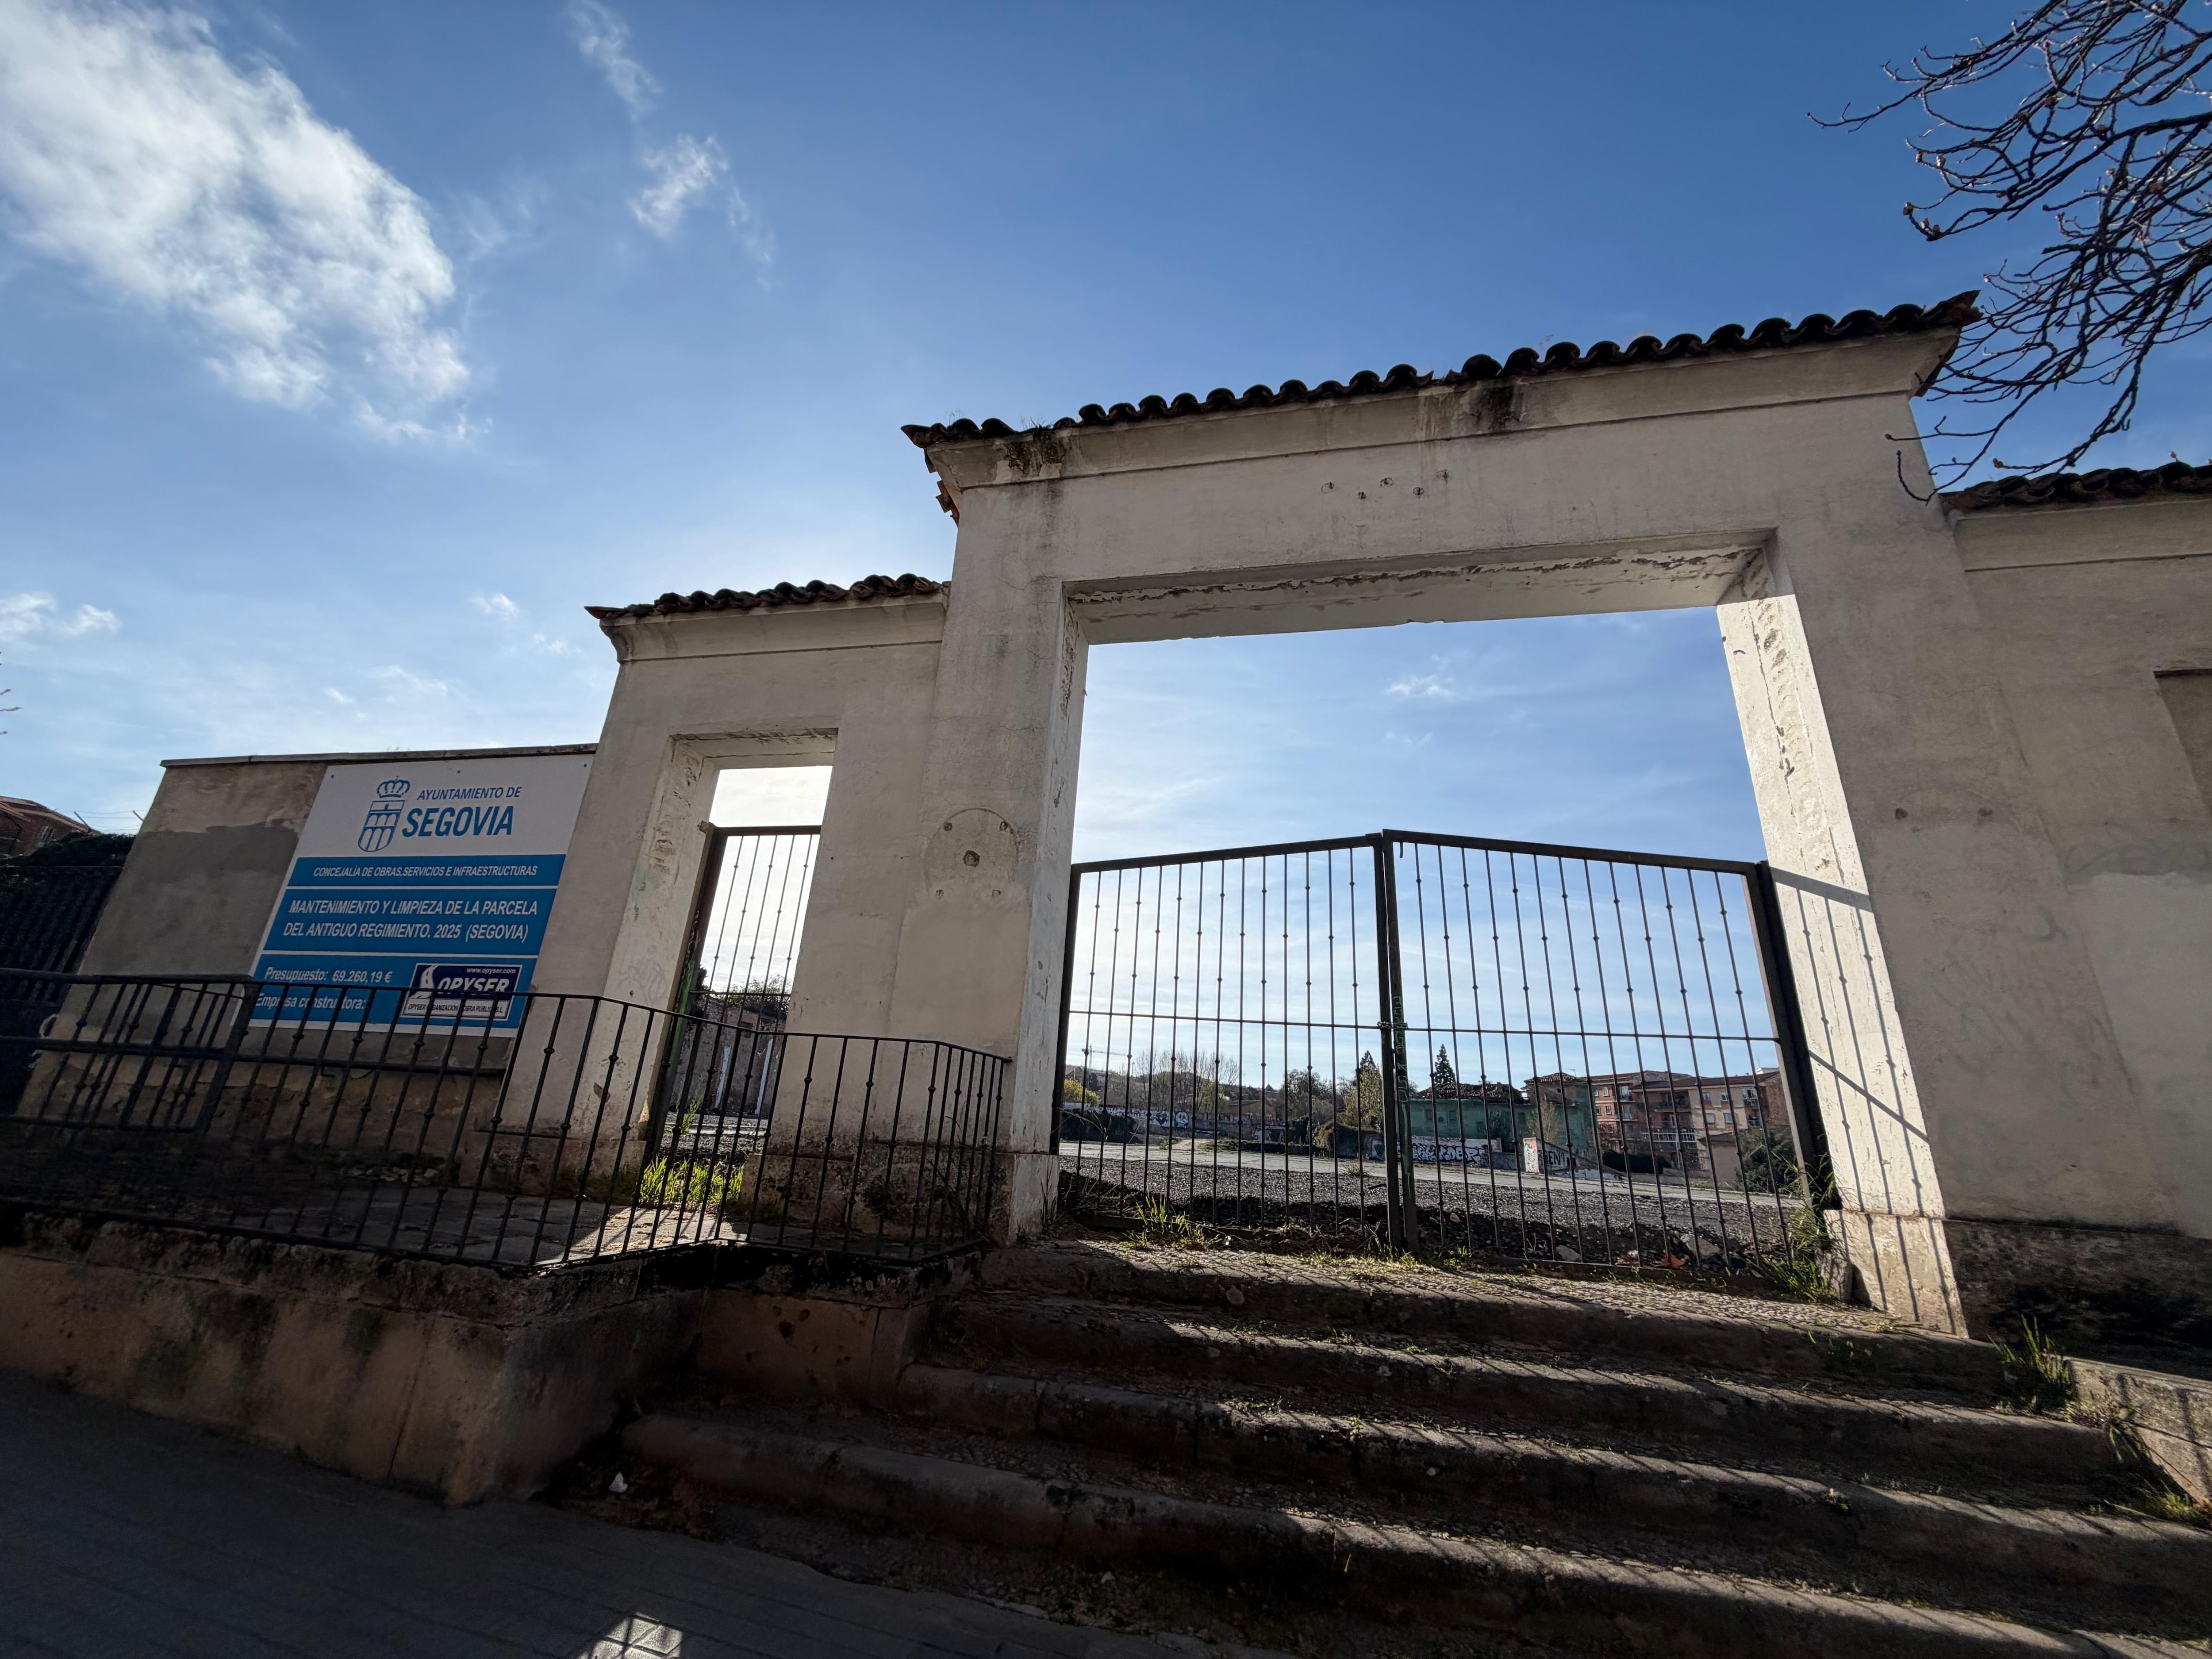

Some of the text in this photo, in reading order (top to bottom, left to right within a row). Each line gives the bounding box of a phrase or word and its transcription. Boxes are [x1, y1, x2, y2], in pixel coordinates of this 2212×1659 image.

[417, 787, 522, 800] AYUNTAMIENTO DE
[402, 806, 514, 837] SEGOVIA
[313, 865, 361, 877] CONCEJALÍA
[361, 867, 373, 876] DE
[445, 866, 452, 876] E
[453, 865, 538, 876] INFRAESTRUCTURAS
[289, 900, 538, 915] MANTENIMIENTO Y LIMPIEZA DE LA PARCELA
[283, 922, 529, 943] DEL ANTIGUO REGIMIENTO. 2025 (SEGOVIA)
[264, 966, 393, 985] Presupuesto: 69.260,19 €
